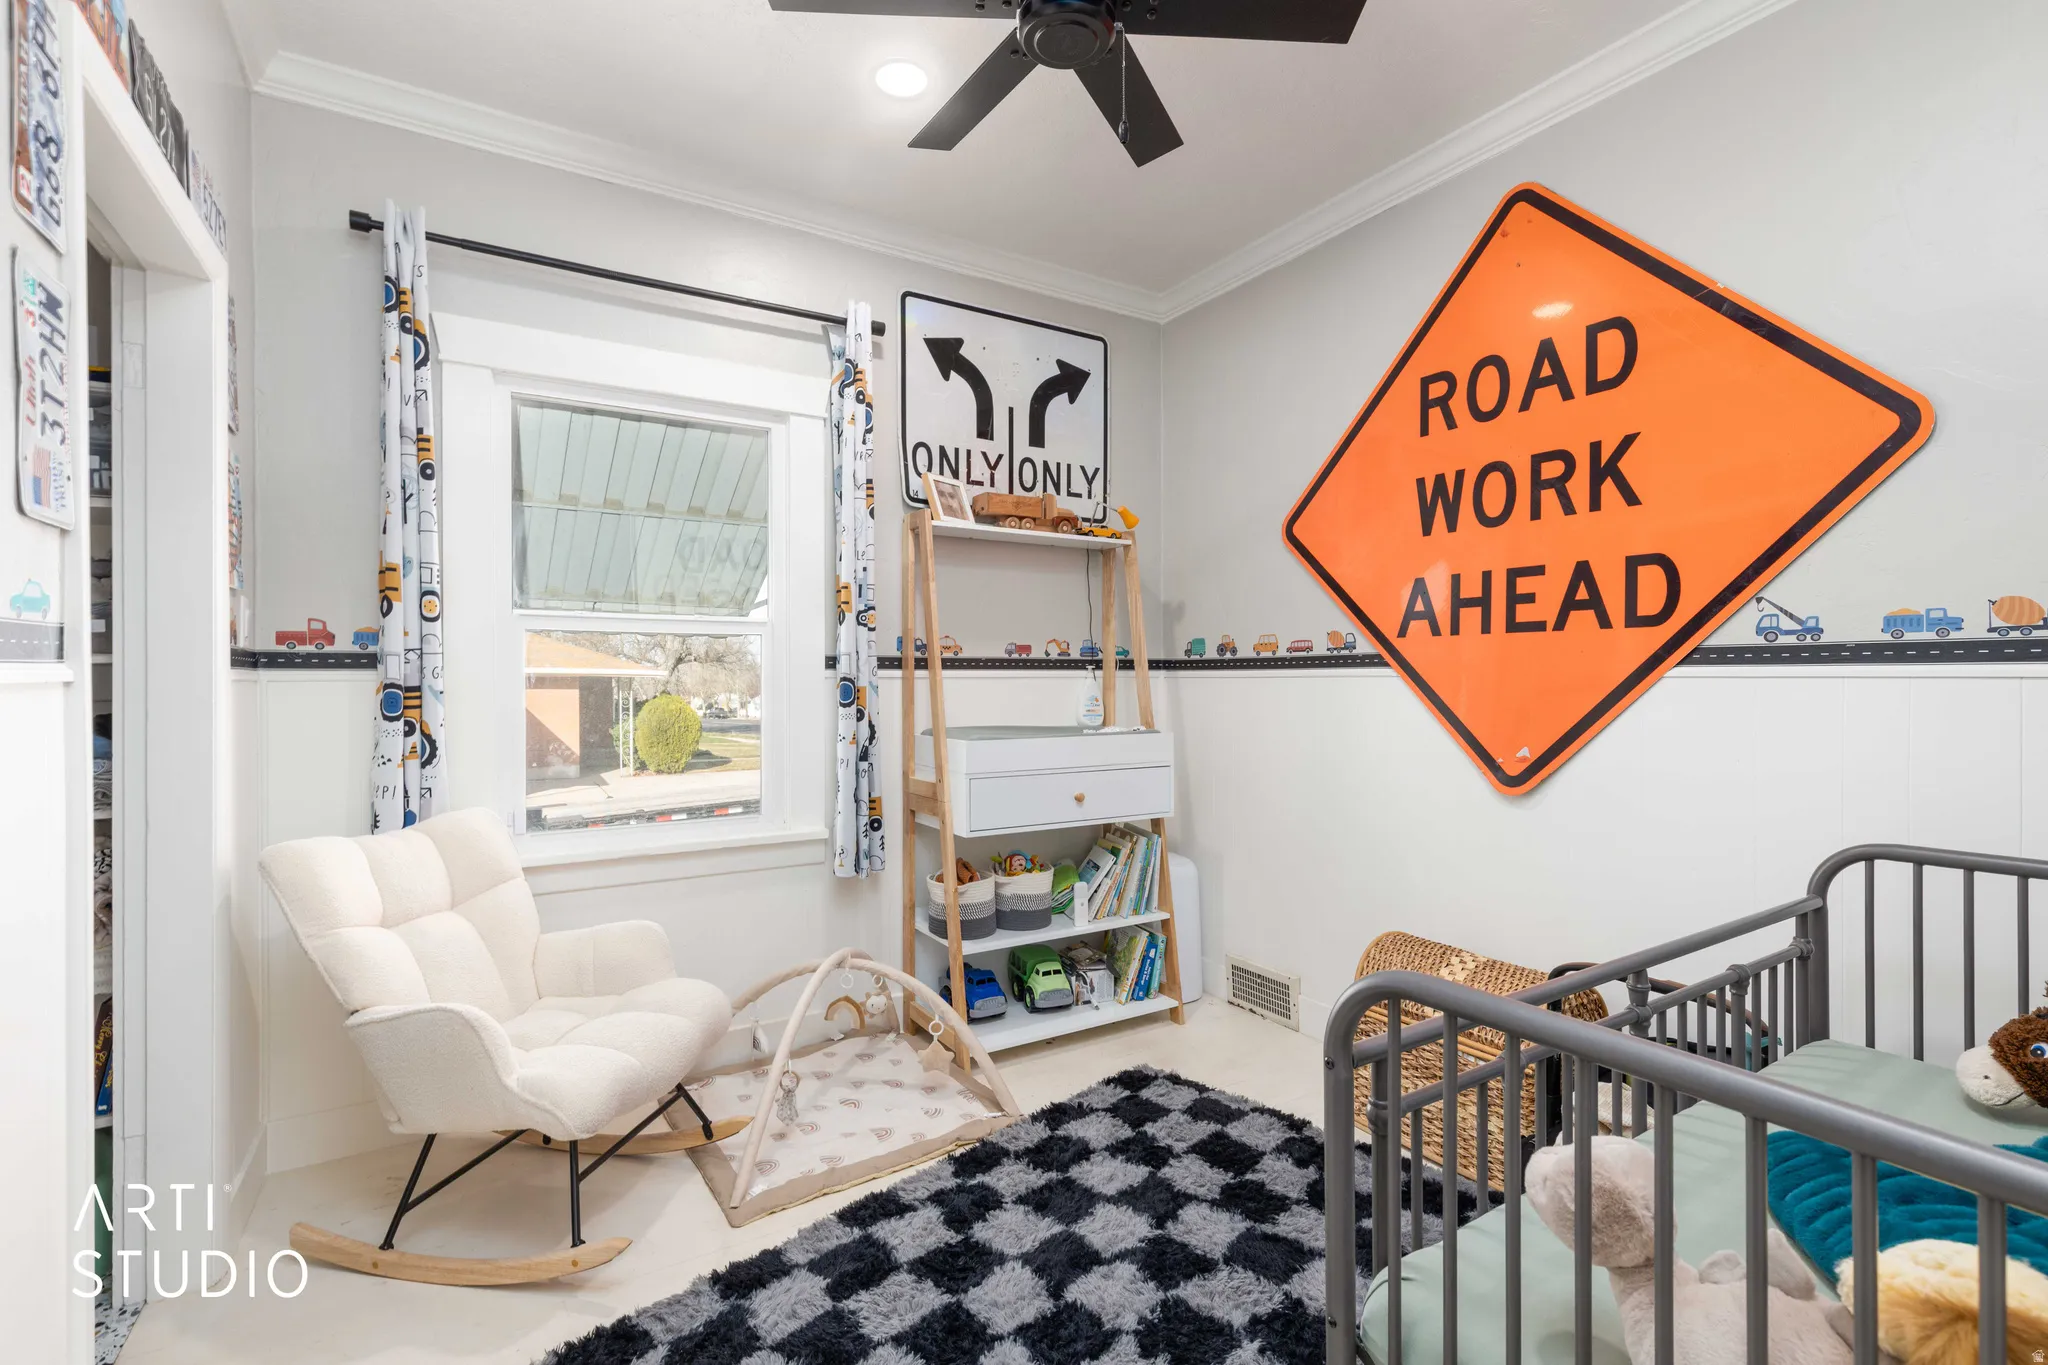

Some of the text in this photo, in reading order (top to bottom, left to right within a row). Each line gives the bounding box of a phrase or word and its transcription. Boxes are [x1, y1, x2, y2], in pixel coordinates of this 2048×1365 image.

[1419, 316, 1639, 438] ROAD
[911, 441, 1004, 488] ONLY
[1018, 456, 1101, 500] ONLY
[1414, 431, 1643, 538] WORK
[1397, 552, 1682, 640] AHEAD
